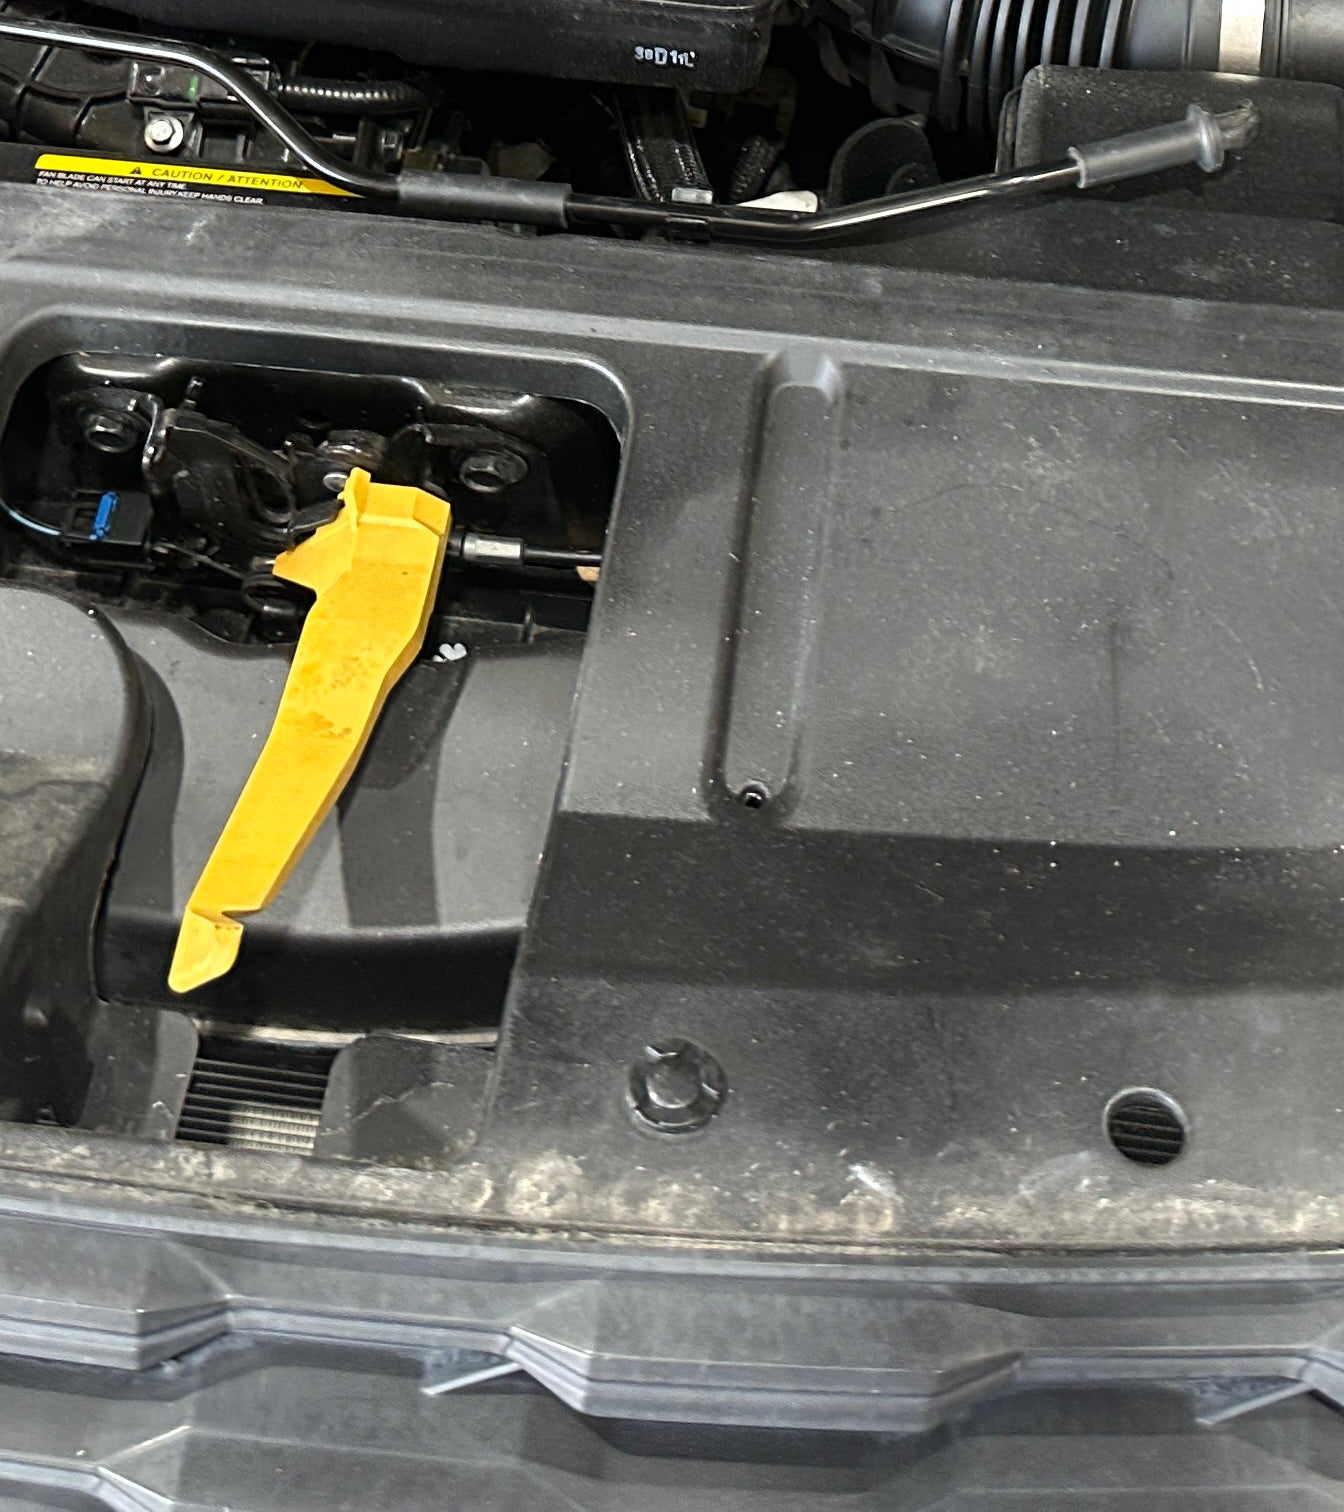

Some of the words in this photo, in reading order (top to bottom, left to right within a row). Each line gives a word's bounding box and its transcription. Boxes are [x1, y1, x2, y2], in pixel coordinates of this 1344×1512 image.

[38, 170, 56, 178] FAN
[57, 172, 86, 181] BLADE
[87, 175, 106, 183] CAN
[107, 176, 135, 185] START
[147, 181, 165, 189] ANY
[73, 181, 100, 190] AVOID
[152, 168, 213, 181] CAUTION
[227, 175, 305, 189] ATTENTION
